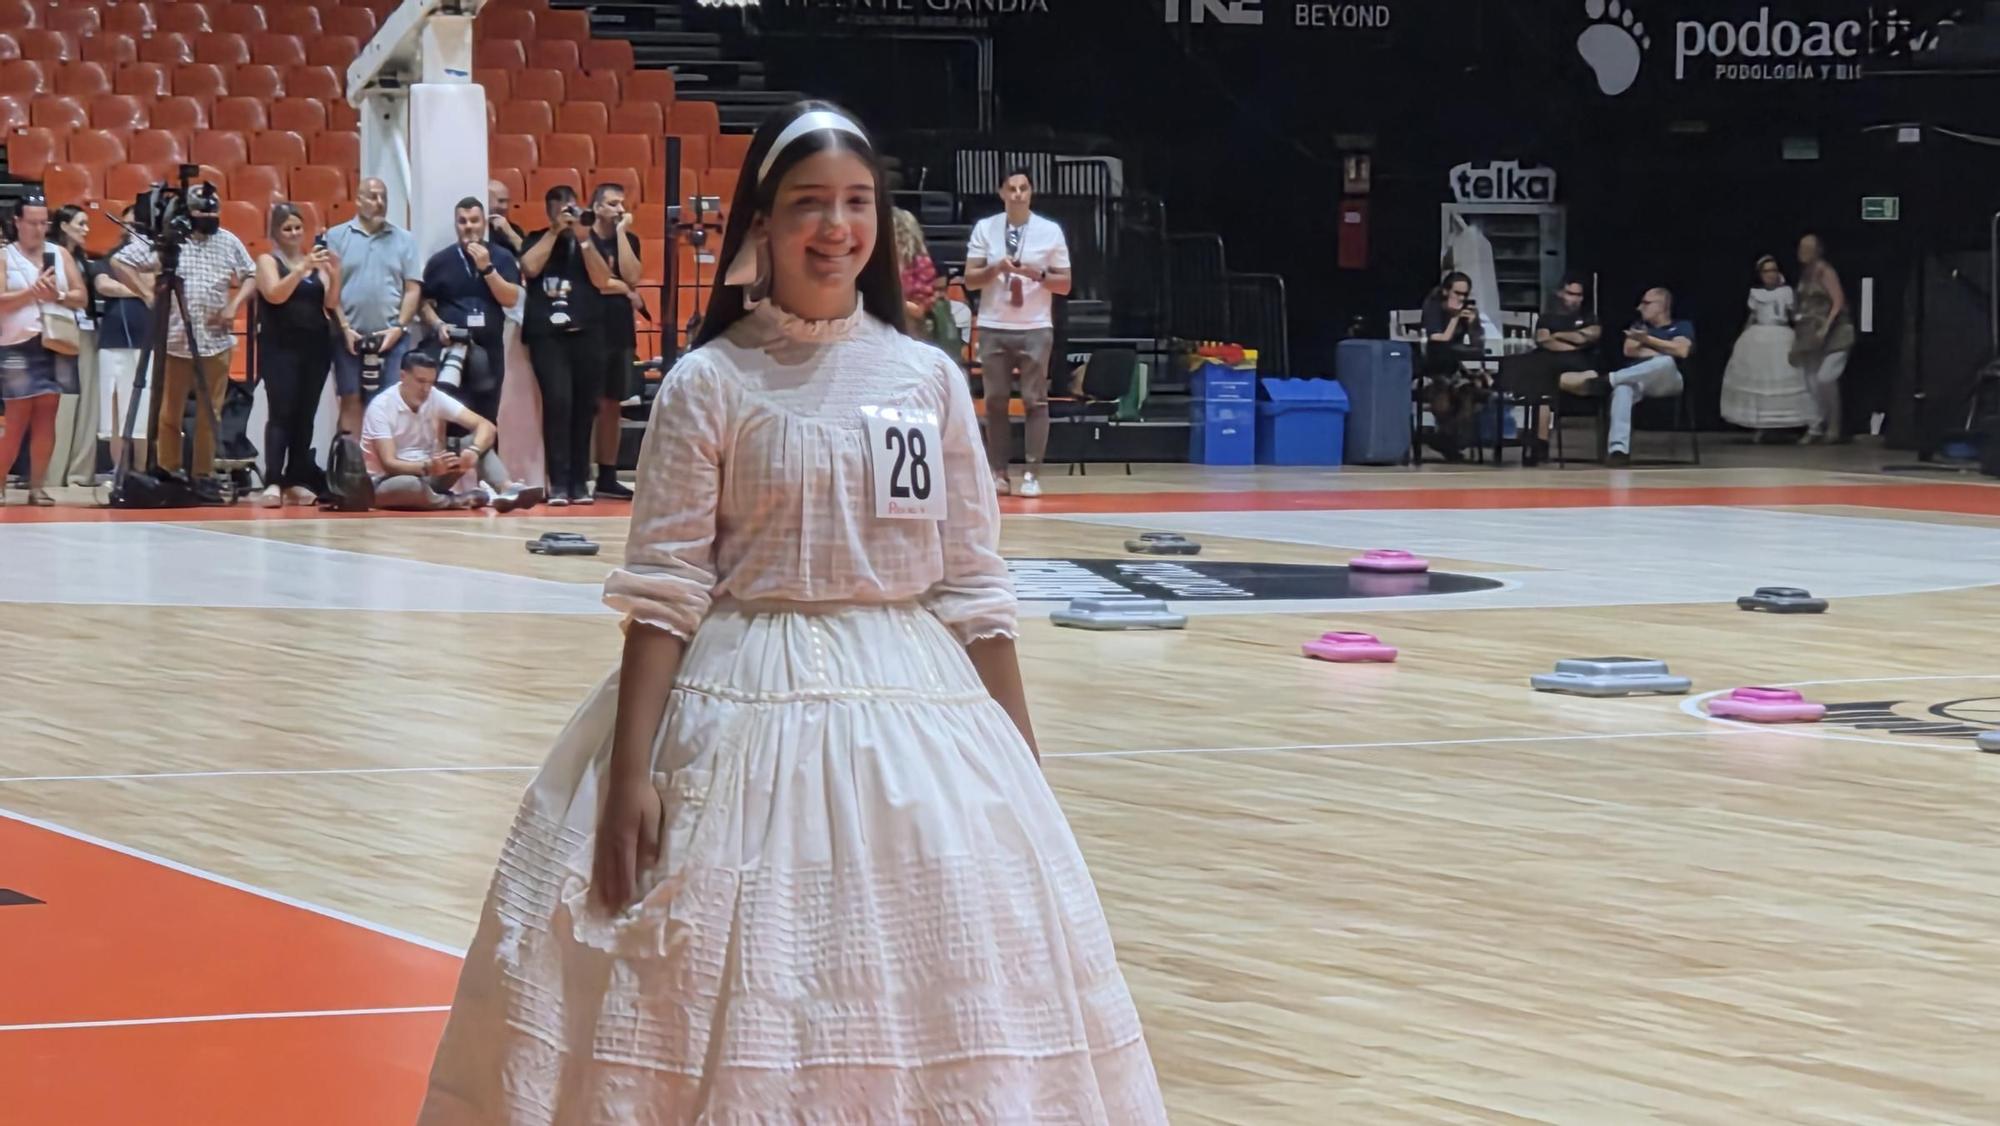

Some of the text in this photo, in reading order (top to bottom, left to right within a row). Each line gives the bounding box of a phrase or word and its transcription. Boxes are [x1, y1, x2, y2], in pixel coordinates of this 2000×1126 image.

[1295, 4, 1390, 27] BEYOND
[1820, 64, 1831, 80] Y
[1457, 166, 1550, 200] telka
[886, 426, 931, 500] 28
